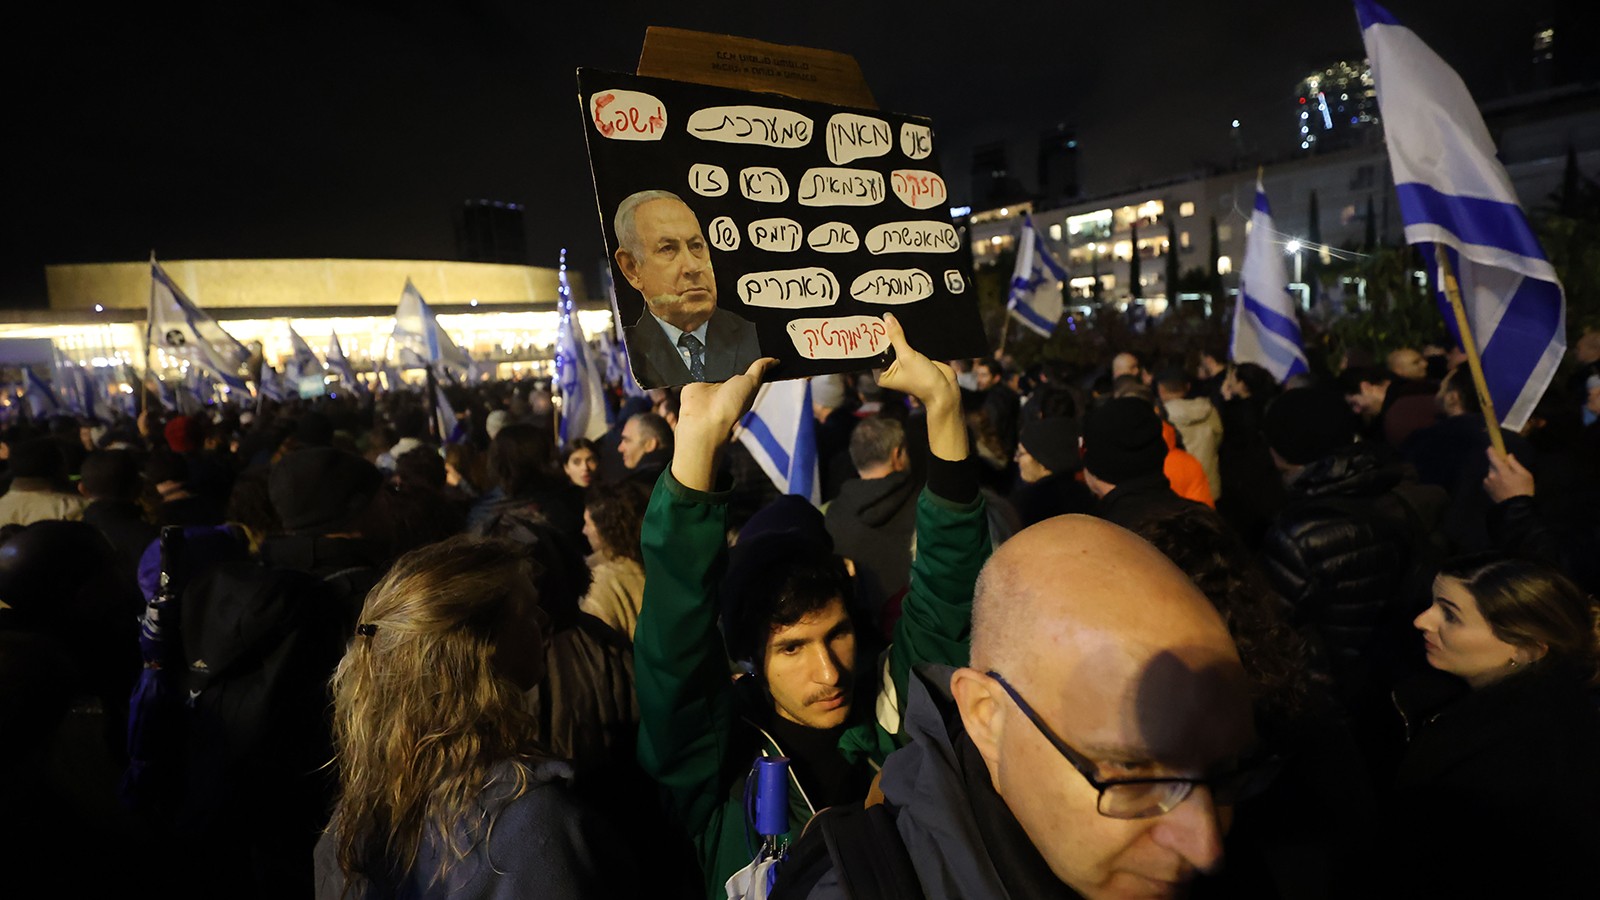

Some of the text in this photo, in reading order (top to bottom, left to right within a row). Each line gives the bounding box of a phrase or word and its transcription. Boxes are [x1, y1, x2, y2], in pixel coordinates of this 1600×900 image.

[695, 115, 808, 143] שמערכת
[831, 122, 889, 161] מאמין
[696, 170, 944, 207] חזקה ועצמאית היא זו
[716, 219, 958, 253] שמאפשרת את קיומם של
[744, 272, 834, 302] האחרים
[854, 272, 932, 297] המוסדות
